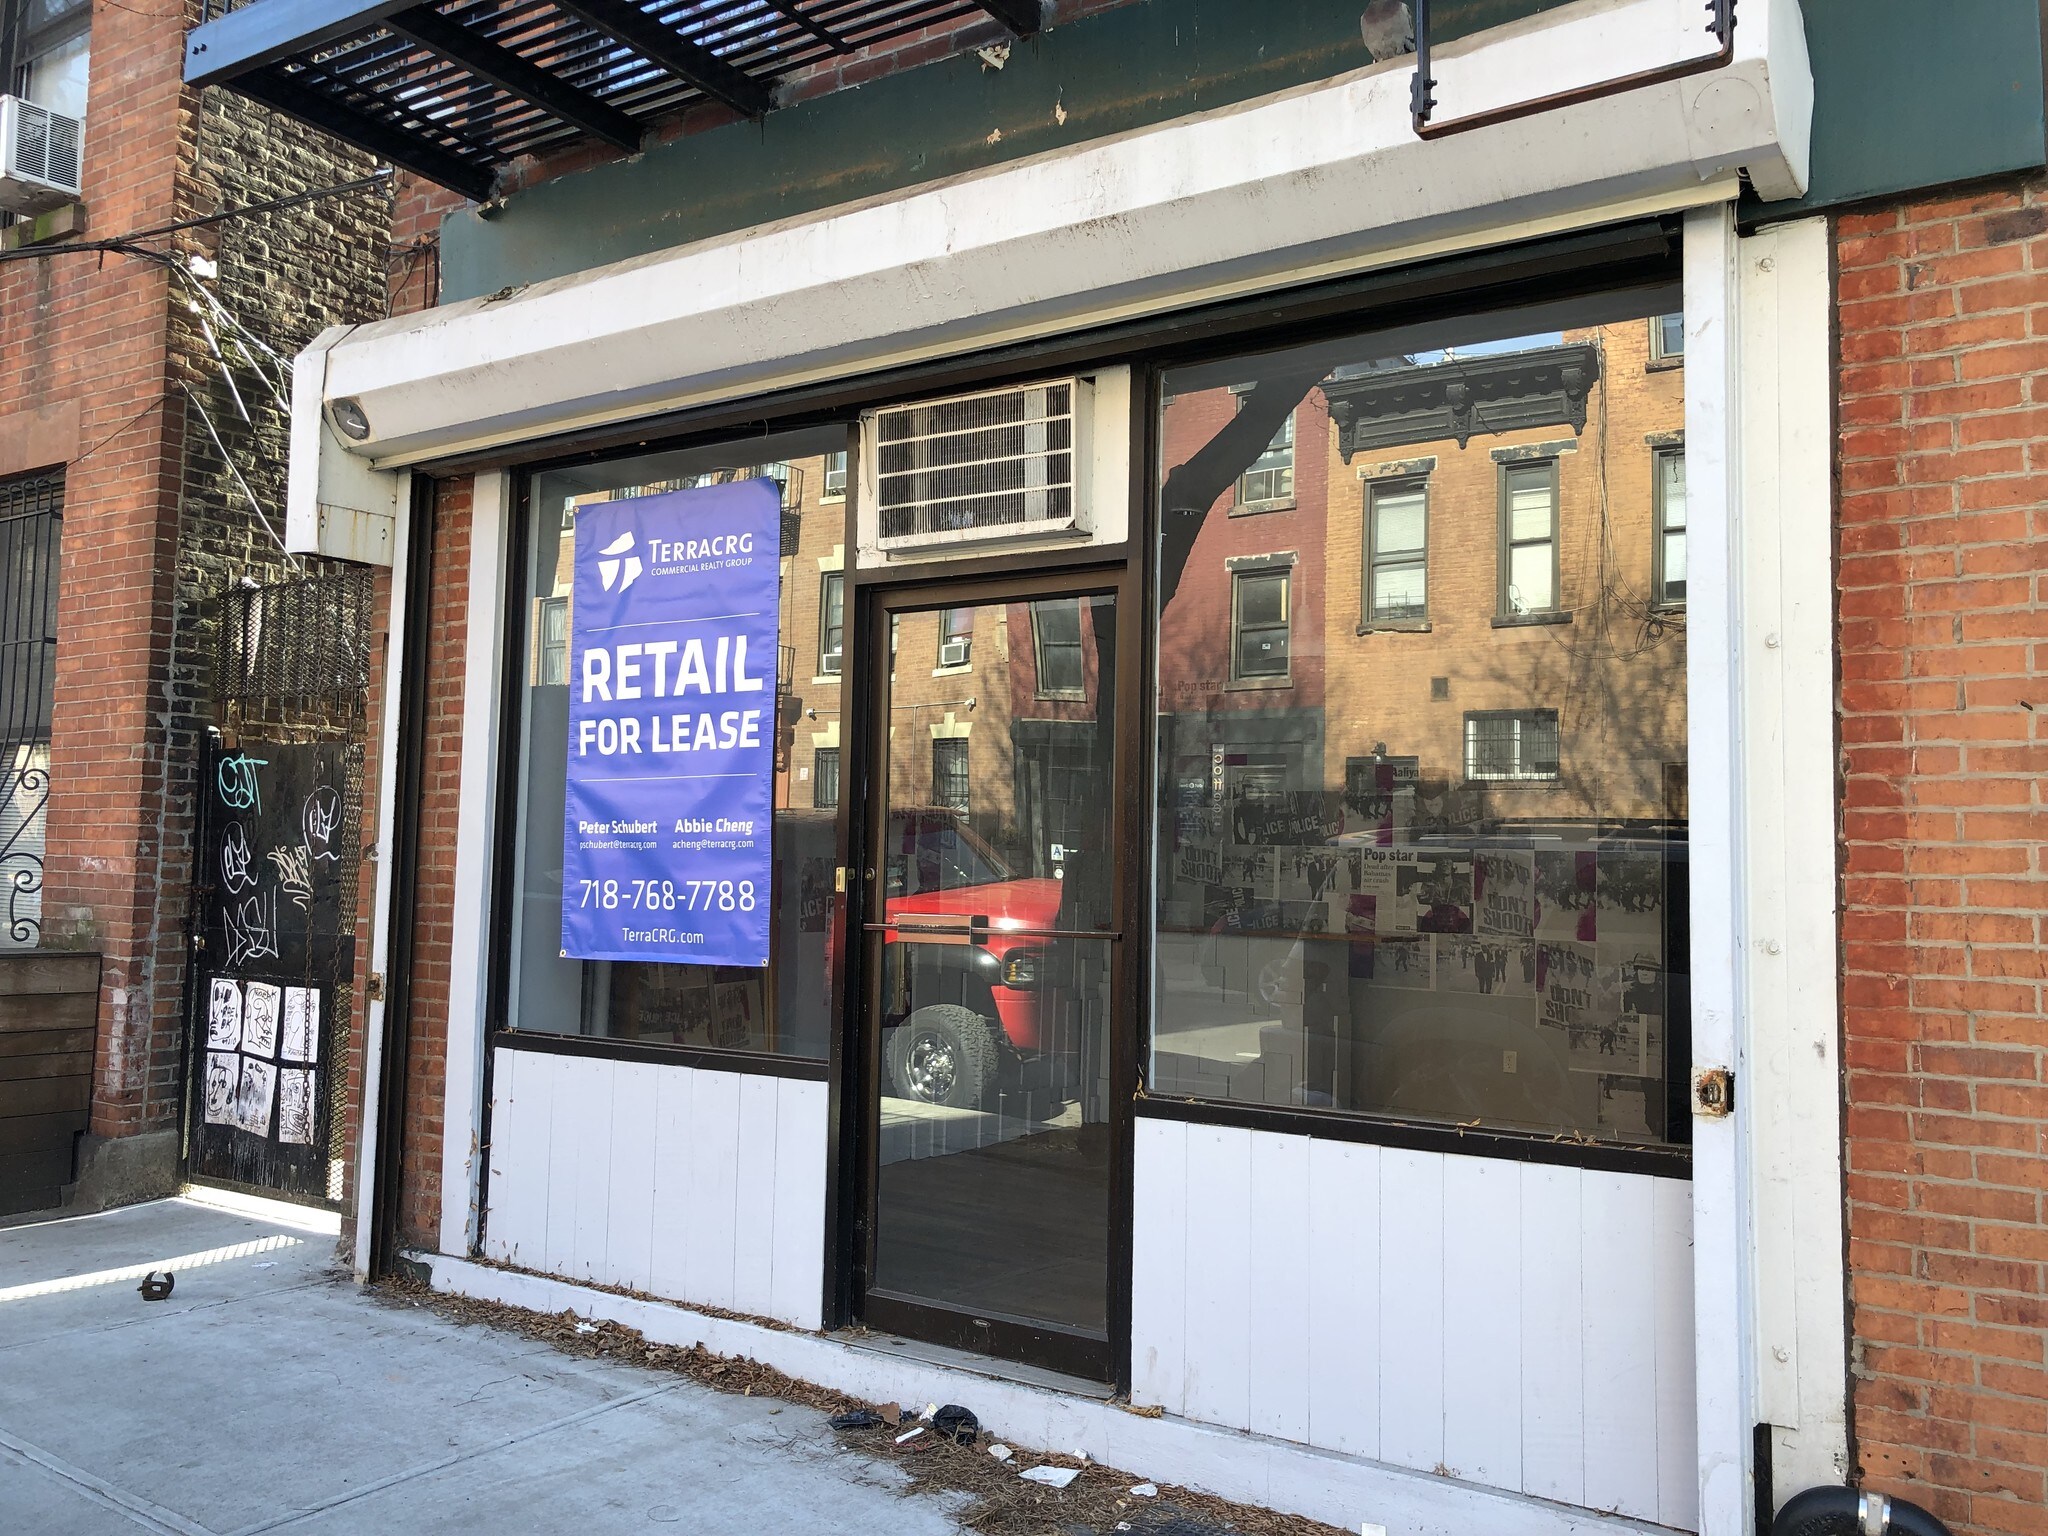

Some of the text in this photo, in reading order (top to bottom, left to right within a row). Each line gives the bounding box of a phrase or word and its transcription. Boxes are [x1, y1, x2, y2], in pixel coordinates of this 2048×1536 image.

[651, 557, 753, 577] COMMERCIAL REALTY GROUP
[582, 634, 763, 704] RETAIL
[579, 709, 761, 756] FOR LEASE
[1391, 766, 1419, 780] Aaliya
[1448, 807, 1478, 825] LICE
[579, 819, 658, 835] Peter Schubert
[674, 817, 754, 836] Abbie Cheng
[1262, 820, 1285, 836] LICE
[579, 838, 657, 851] pschubert@terracrg.com
[672, 838, 754, 851] acheng@terracrg.com
[1364, 848, 1414, 863] Pop star
[1380, 863, 1394, 871] after
[579, 879, 755, 912] 718-768-7788
[622, 928, 704, 944] TerraCRG.com
